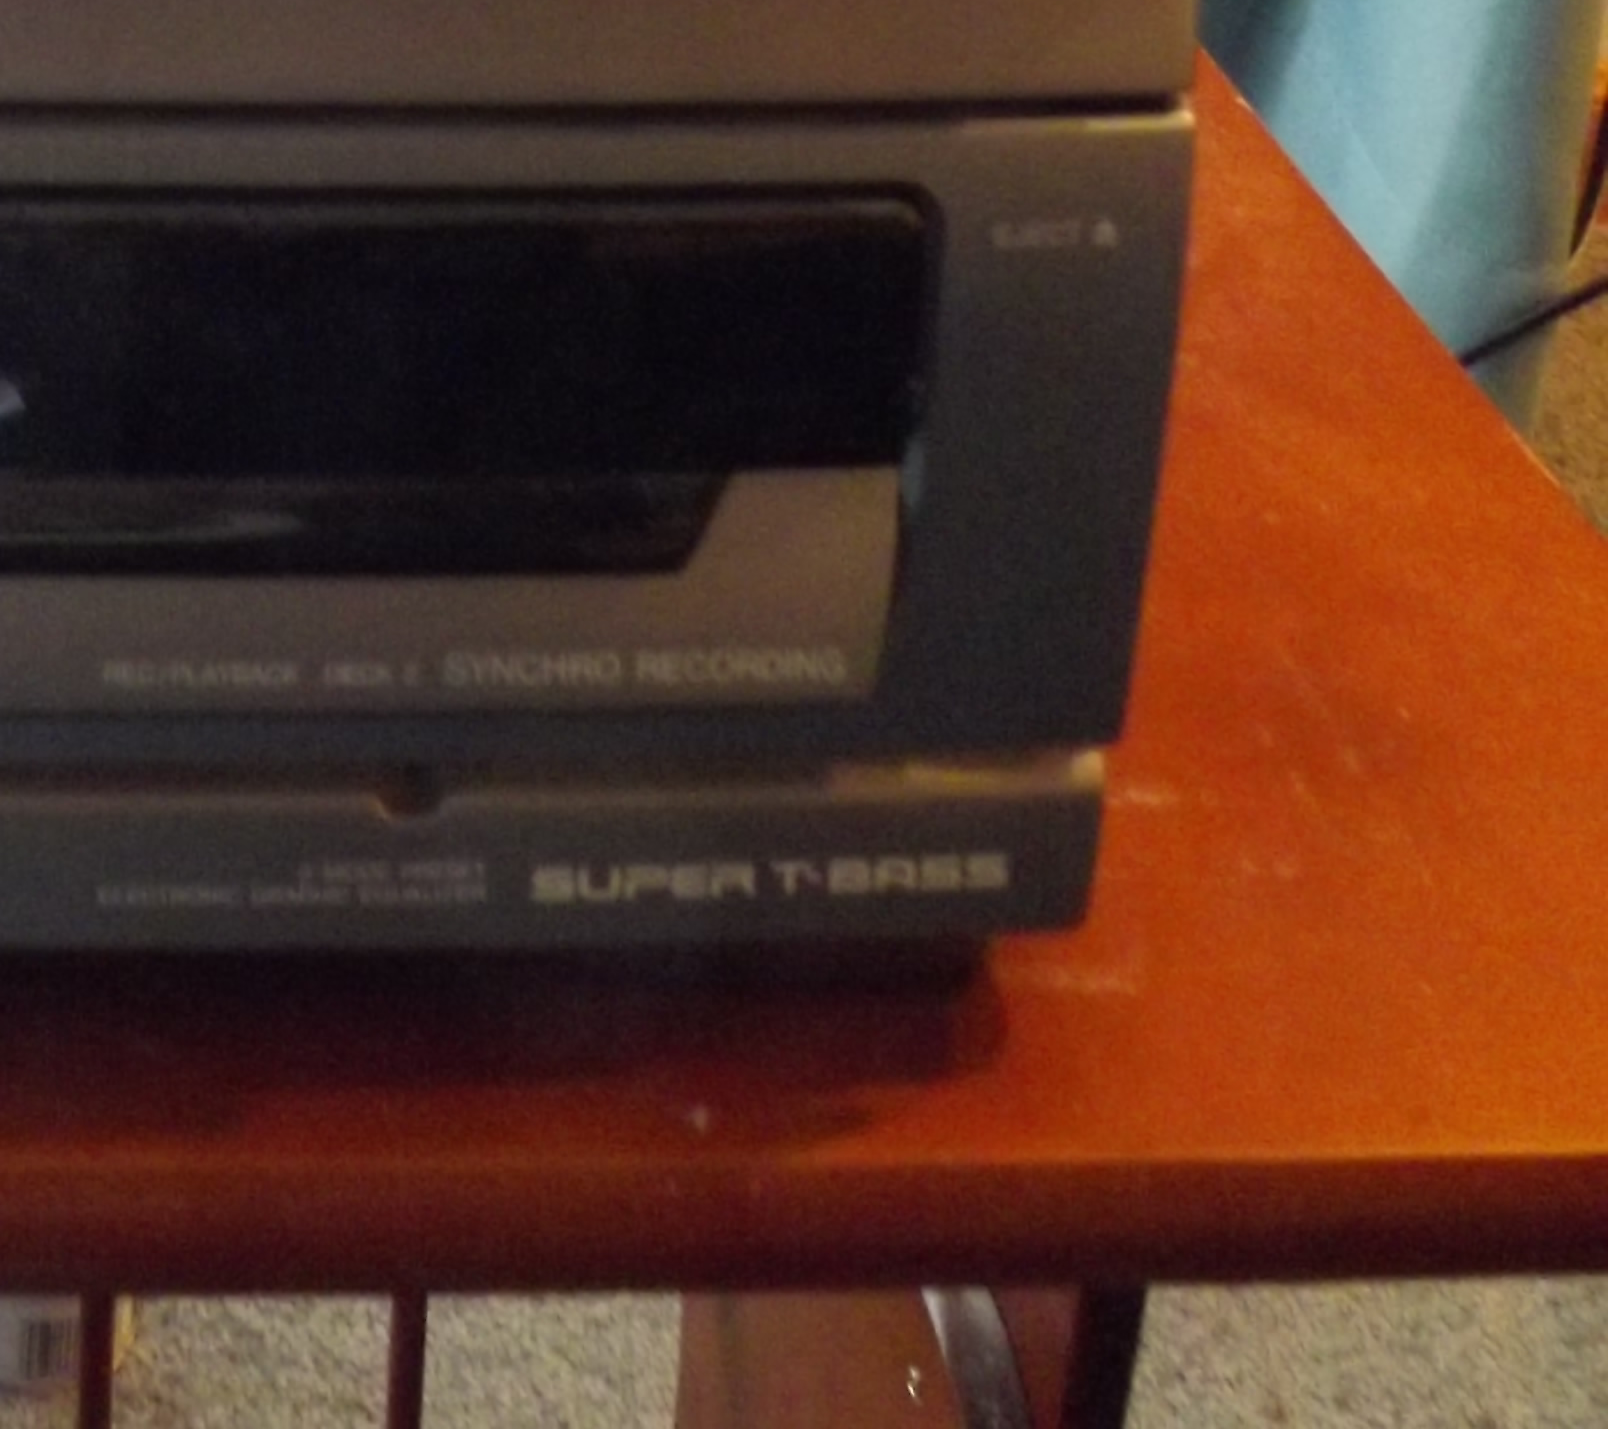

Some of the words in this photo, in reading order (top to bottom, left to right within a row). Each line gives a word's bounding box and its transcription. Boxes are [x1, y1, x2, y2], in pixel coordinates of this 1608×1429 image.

[443, 652, 621, 686] SYNCHRO
[635, 651, 847, 686] RECORDING
[531, 864, 756, 902] SUPER
